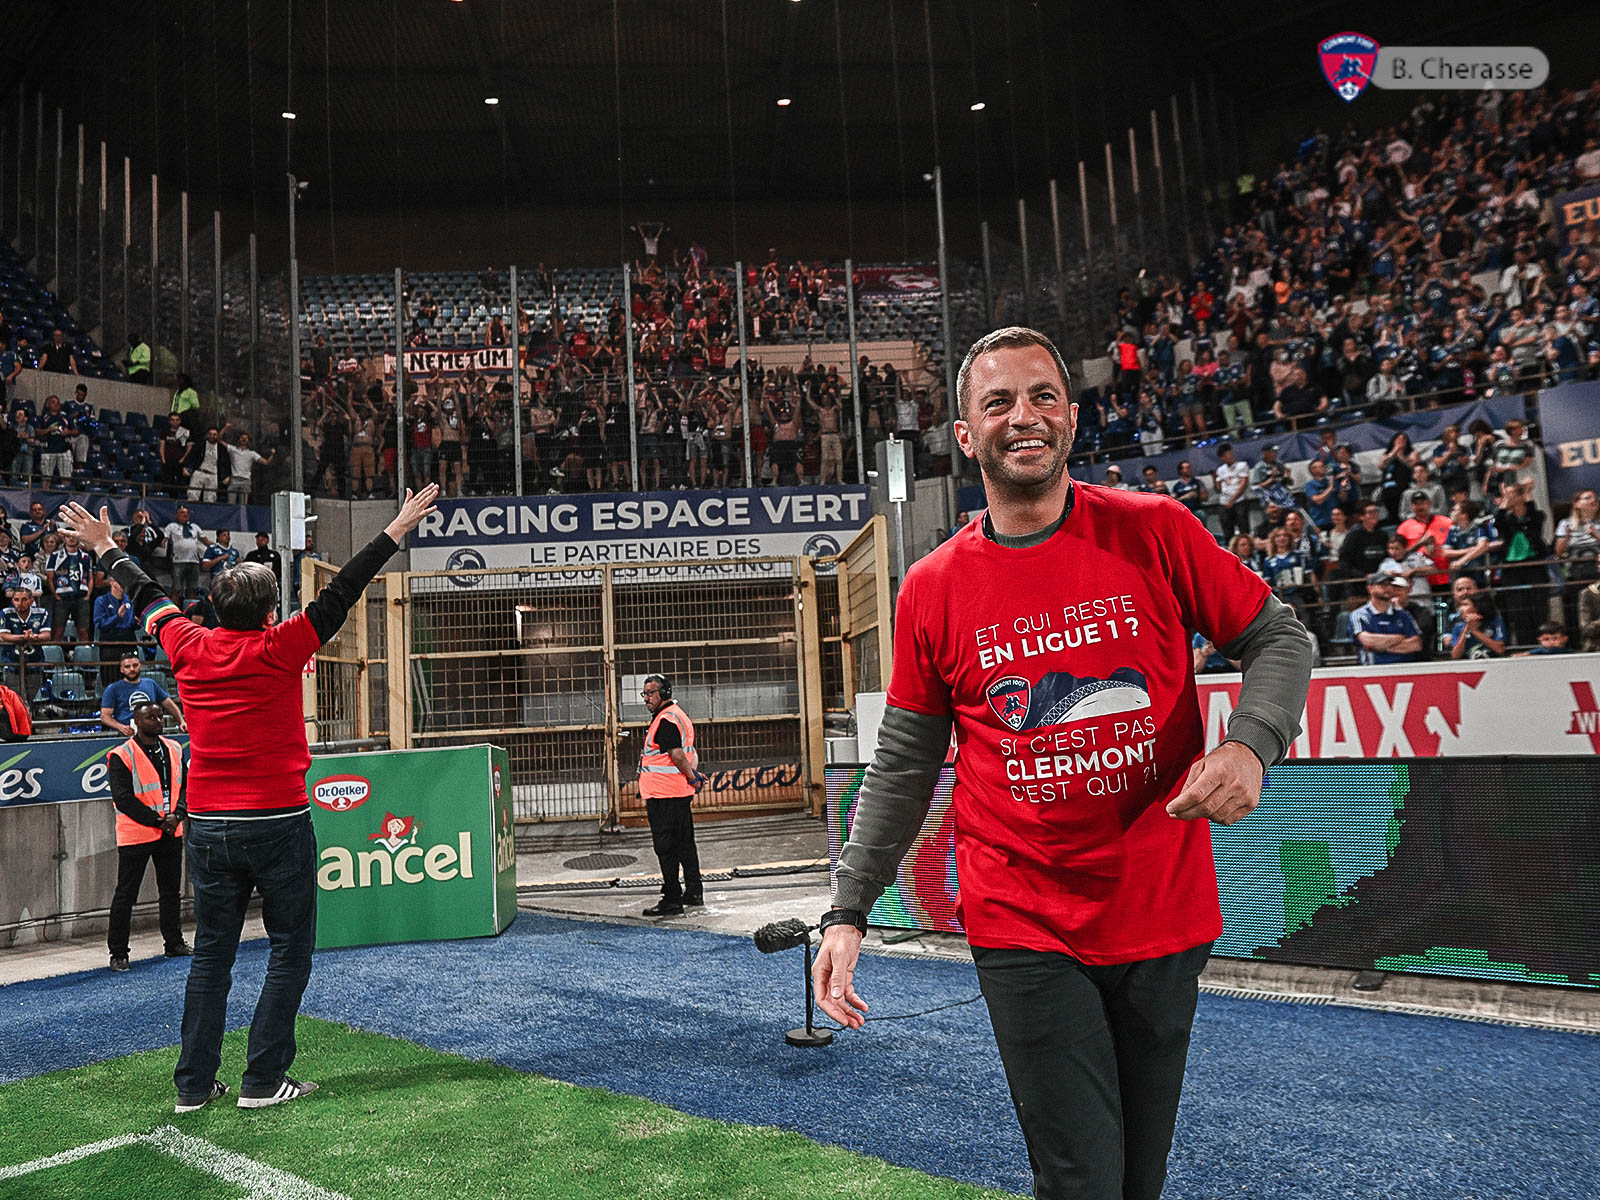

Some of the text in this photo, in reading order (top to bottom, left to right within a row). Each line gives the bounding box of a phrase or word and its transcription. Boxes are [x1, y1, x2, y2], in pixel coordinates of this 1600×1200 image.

[418, 492, 867, 538] RACING ESPACE VERT
[519, 562, 638, 582] PELOUES
[688, 555, 773, 575] RACING
[530, 538, 761, 564] LE PARTENAIRE DES
[976, 594, 1136, 647] ET QUI RESTE
[979, 643, 1014, 670] EN
[1022, 620, 1101, 658] LIGUE
[1000, 716, 1156, 756] SI C'EST PAS
[1006, 739, 1156, 782] CLERMONT
[1010, 781, 1071, 804] C'EST
[1087, 772, 1128, 797] QUI
[317, 831, 474, 891] ancel
